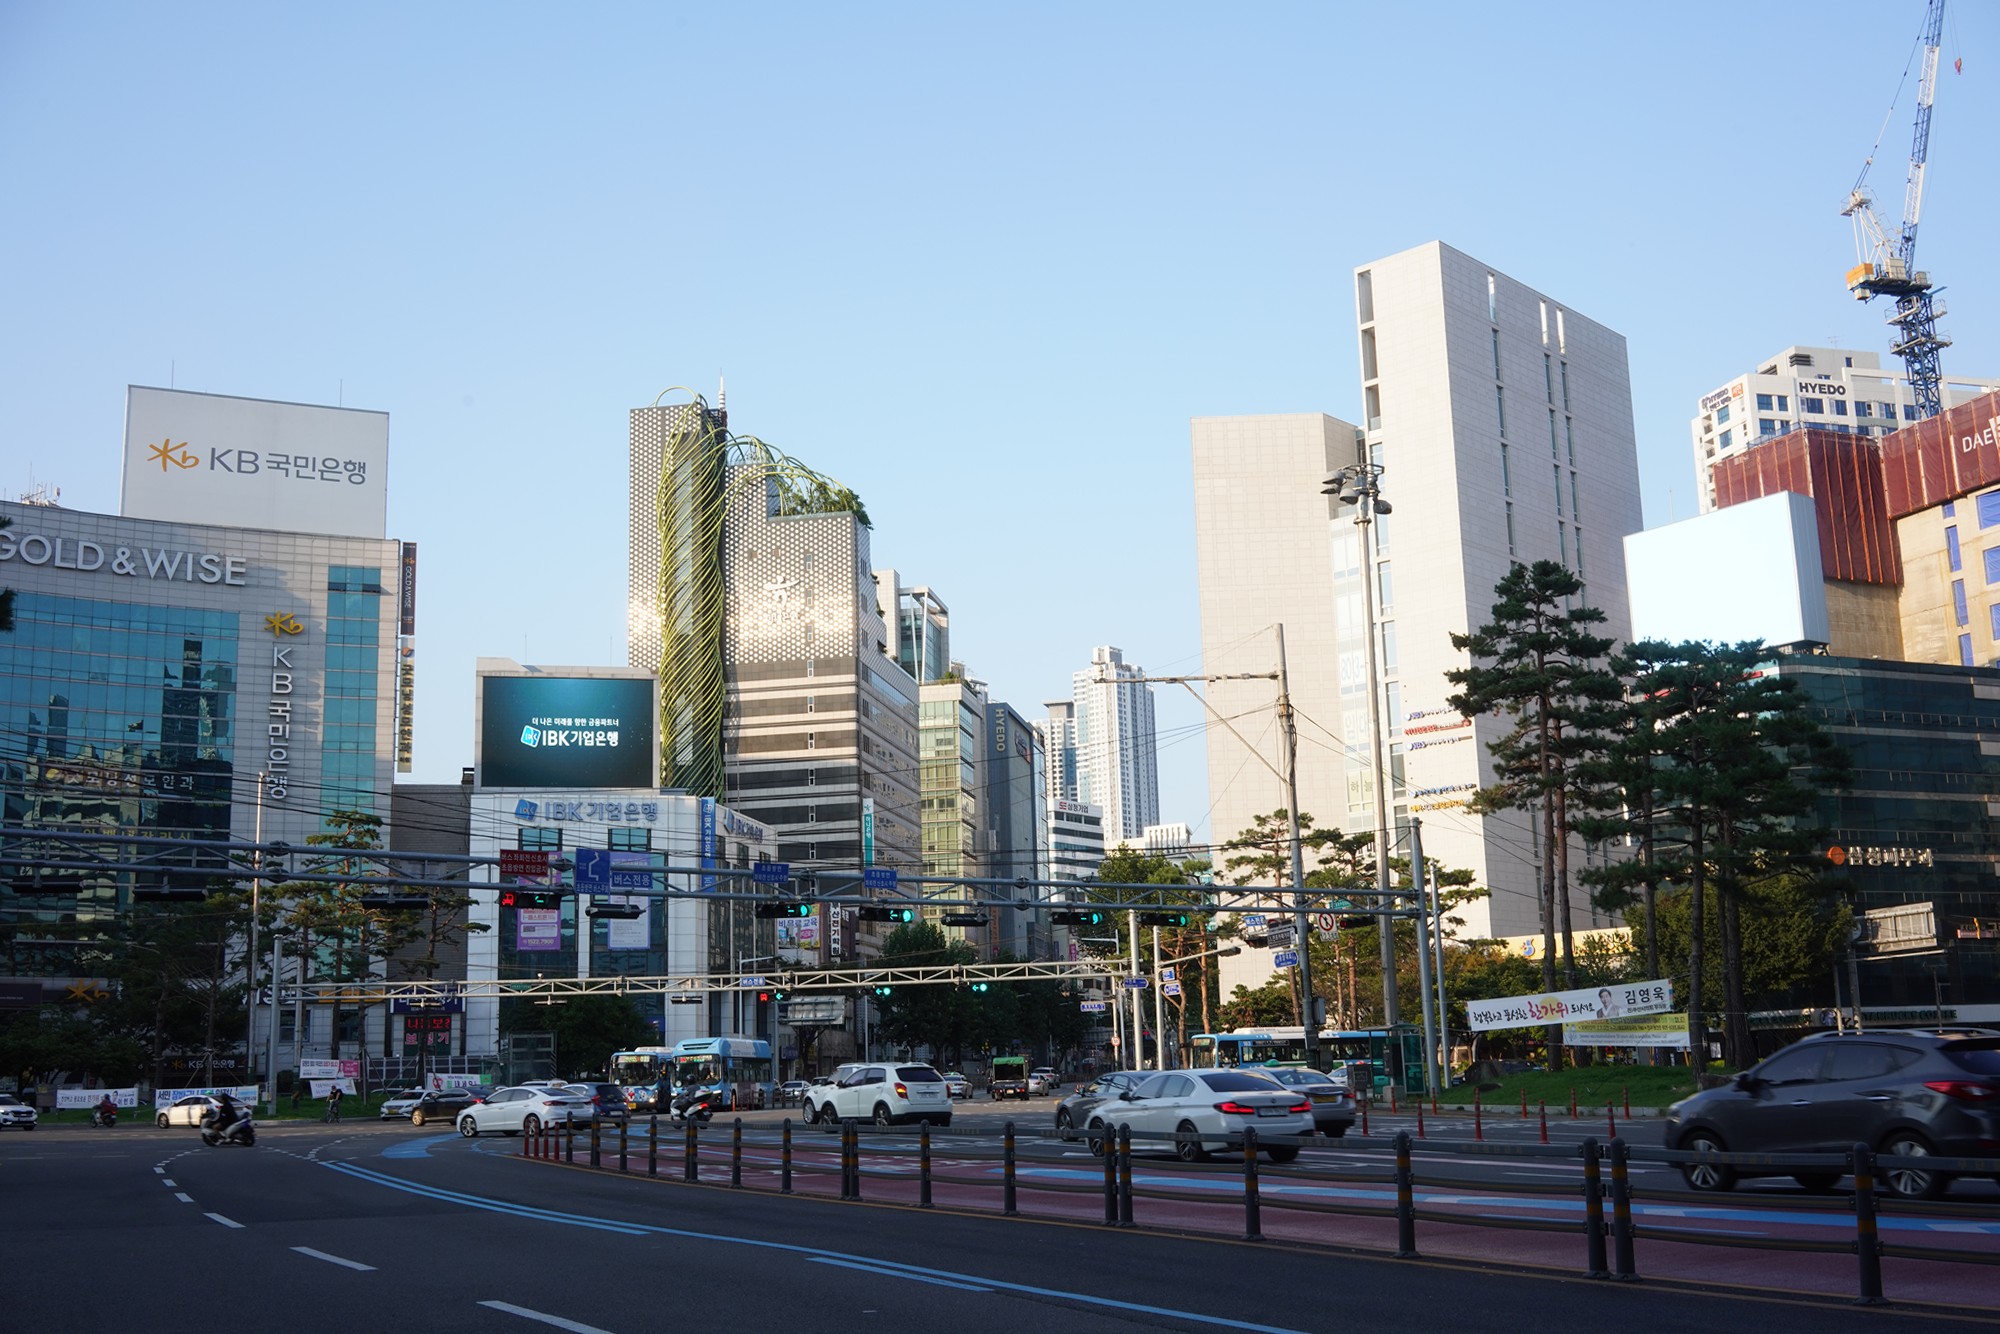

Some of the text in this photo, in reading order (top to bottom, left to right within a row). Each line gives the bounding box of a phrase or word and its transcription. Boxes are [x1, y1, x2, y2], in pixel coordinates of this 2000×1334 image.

[1799, 382, 1846, 396] HYEDO
[0, 530, 105, 572] GOLD
[141, 547, 248, 587] WISE
[532, 717, 619, 727] 더 나은 미래를 향한 금융파트너
[995, 708, 1006, 752] HYEDO
[542, 730, 619, 747] IBK기업은행
[501, 853, 513, 861] 버스
[612, 874, 651, 887] 버스전용
[1624, 986, 1665, 1005] 김영욱
[1473, 1009, 1503, 1025] 행복하고
[1503, 1007, 1528, 1022] 풍성한
[1527, 1000, 1569, 1021] 한가위
[1570, 1002, 1596, 1015] 되세요
